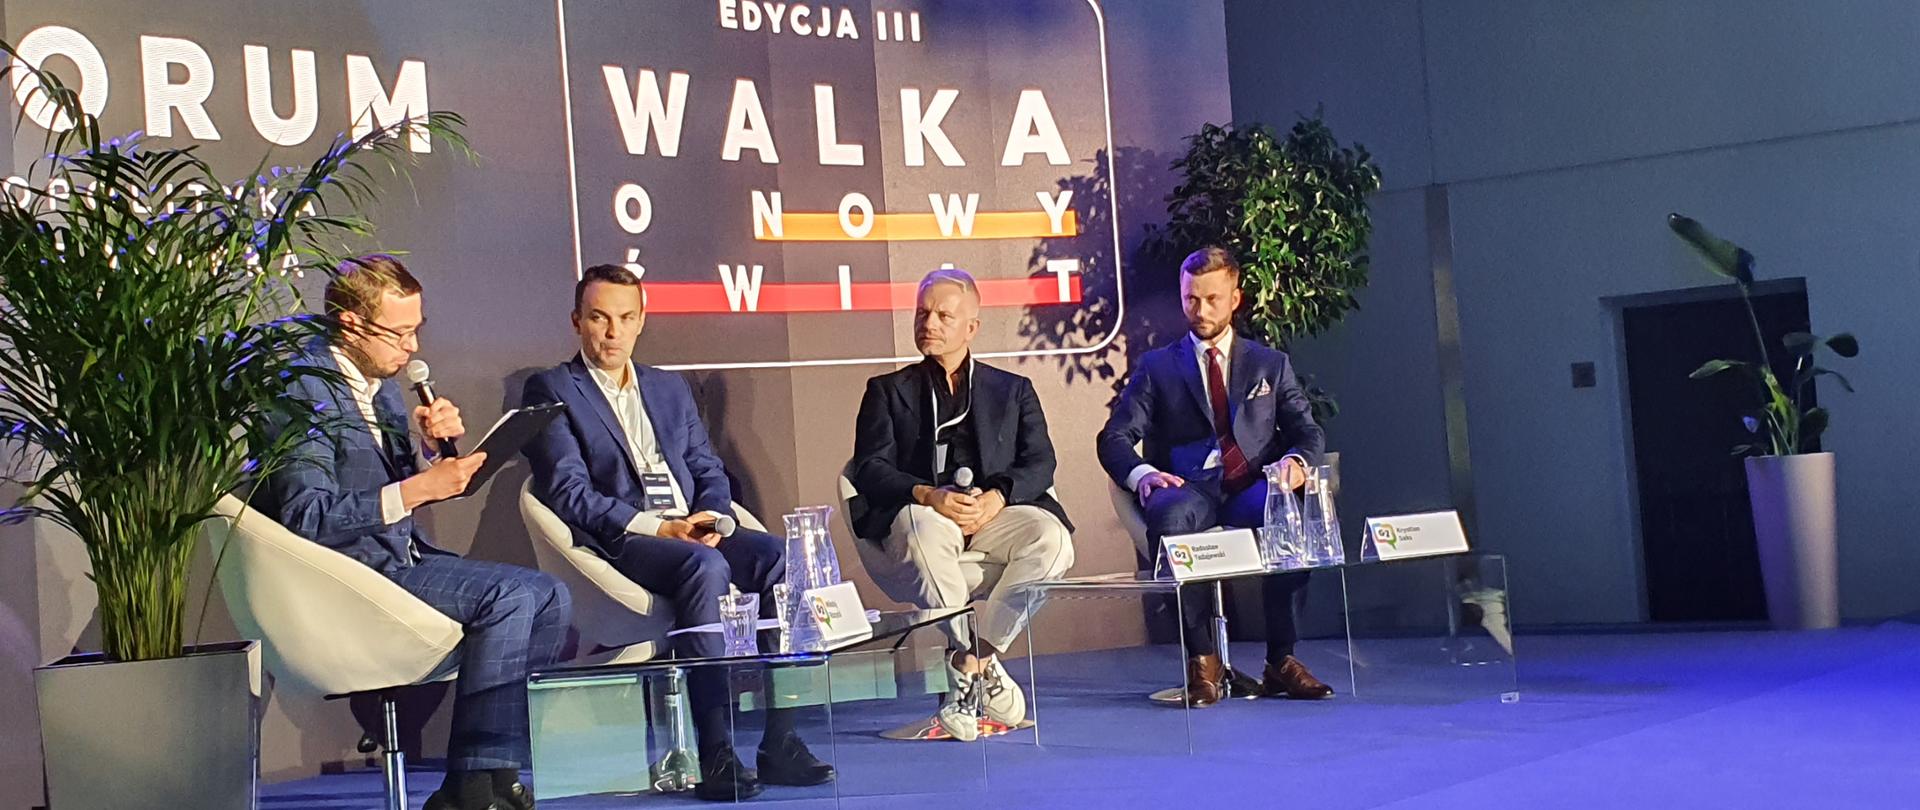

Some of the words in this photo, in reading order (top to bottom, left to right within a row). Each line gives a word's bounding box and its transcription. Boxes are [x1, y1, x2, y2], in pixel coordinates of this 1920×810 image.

[719, 0, 859, 40] EDYCJA
[876, 11, 921, 42] III
[11, 25, 432, 153] ORUM
[602, 64, 1072, 167] WALKA
[615, 184, 652, 234] O
[751, 190, 1073, 238] NOWY
[622, 248, 1080, 312] WIT
